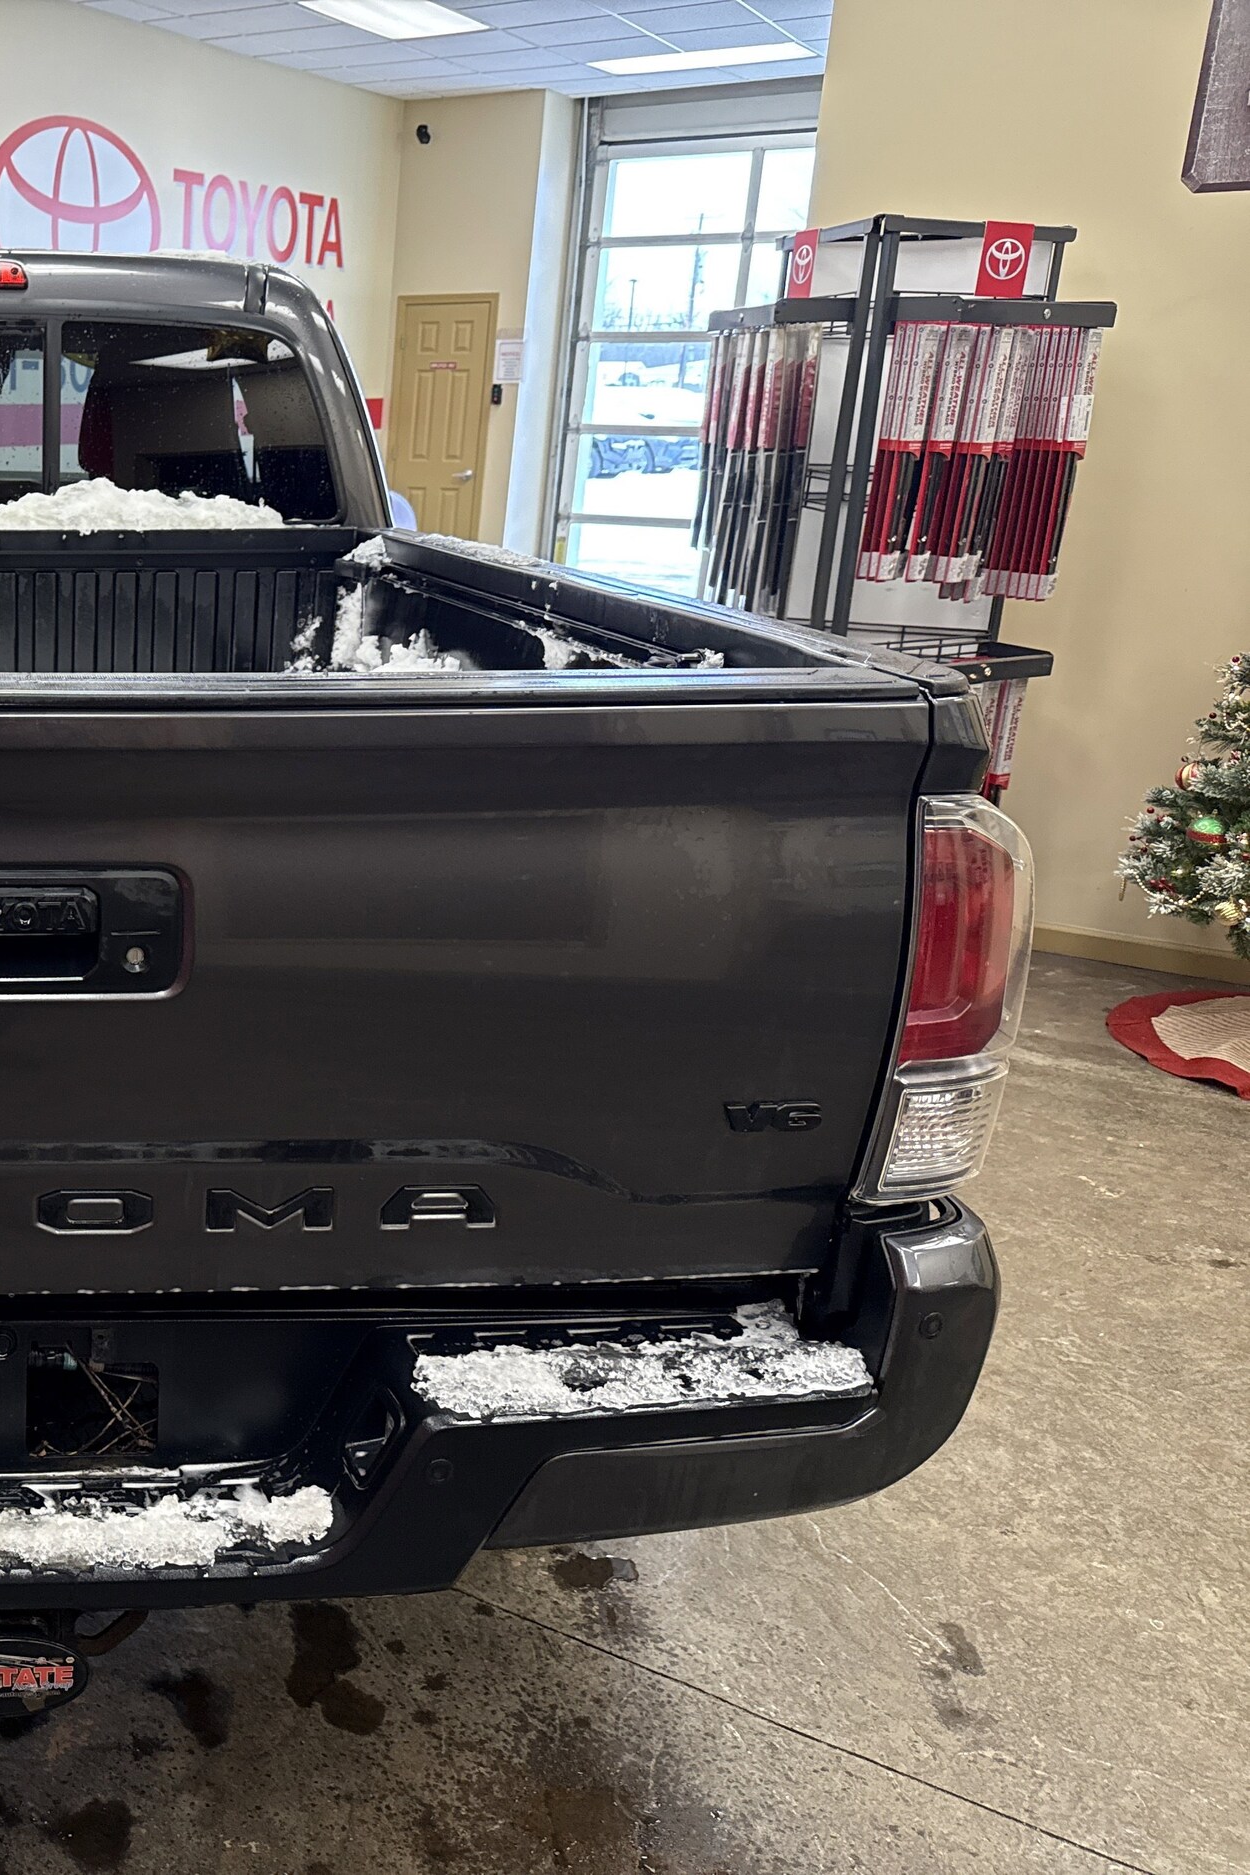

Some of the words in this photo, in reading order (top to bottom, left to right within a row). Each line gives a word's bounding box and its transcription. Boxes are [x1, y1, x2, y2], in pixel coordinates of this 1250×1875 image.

[173, 168, 344, 268] TOYOTA
[949, 352, 966, 426] ALL-WEATHER
[724, 1100, 822, 1132] V6
